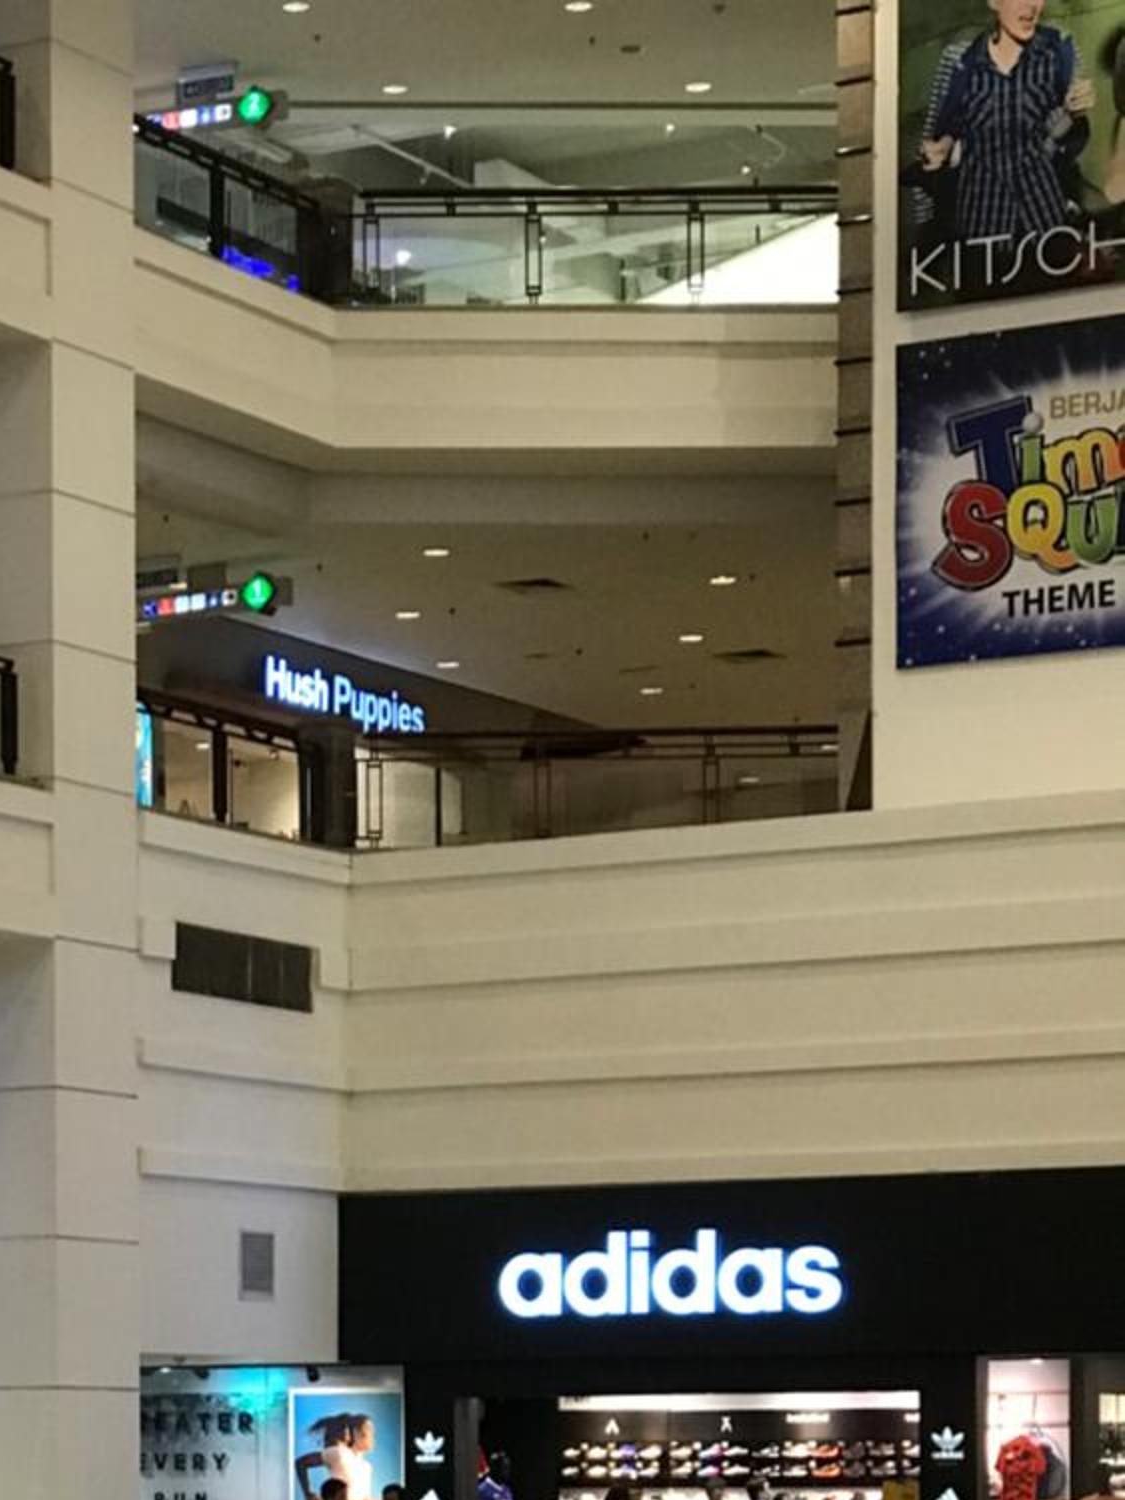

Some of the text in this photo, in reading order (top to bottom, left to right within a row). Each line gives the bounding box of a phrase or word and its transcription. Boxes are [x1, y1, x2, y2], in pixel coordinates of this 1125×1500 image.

[931, 478, 1125, 592] SQU
[1002, 580, 1116, 618] THEME
[265, 655, 425, 734] Hush Puppies
[498, 1228, 842, 1317] adidas
